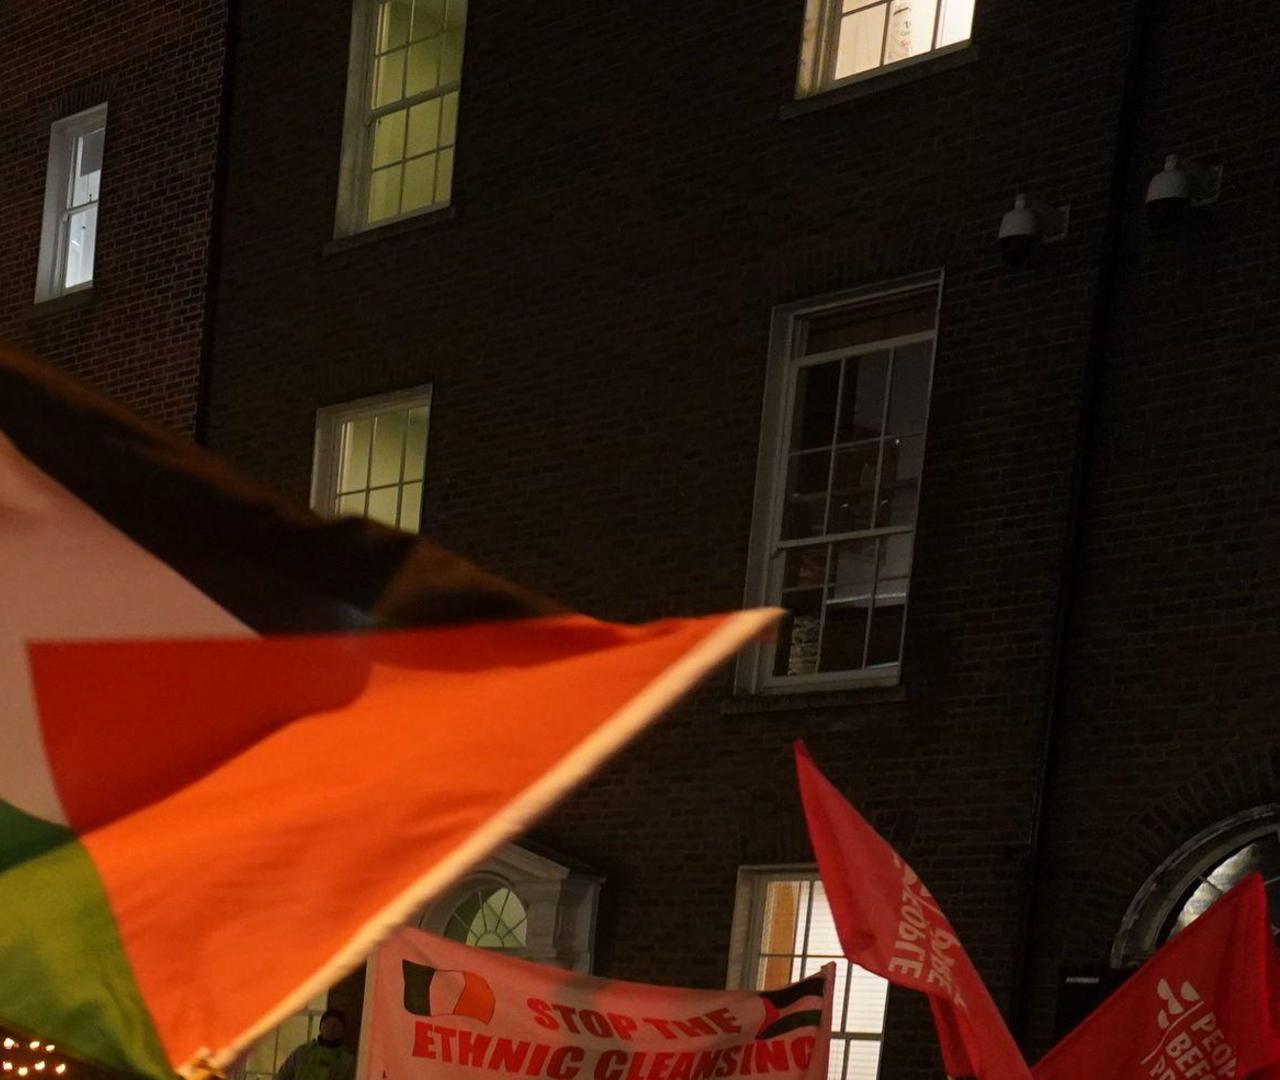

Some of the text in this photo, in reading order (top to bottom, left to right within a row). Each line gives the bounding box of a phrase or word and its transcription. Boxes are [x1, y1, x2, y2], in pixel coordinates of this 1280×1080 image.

[526, 998, 743, 1041] STOP THE
[411, 1020, 587, 1080] ETHNIC
